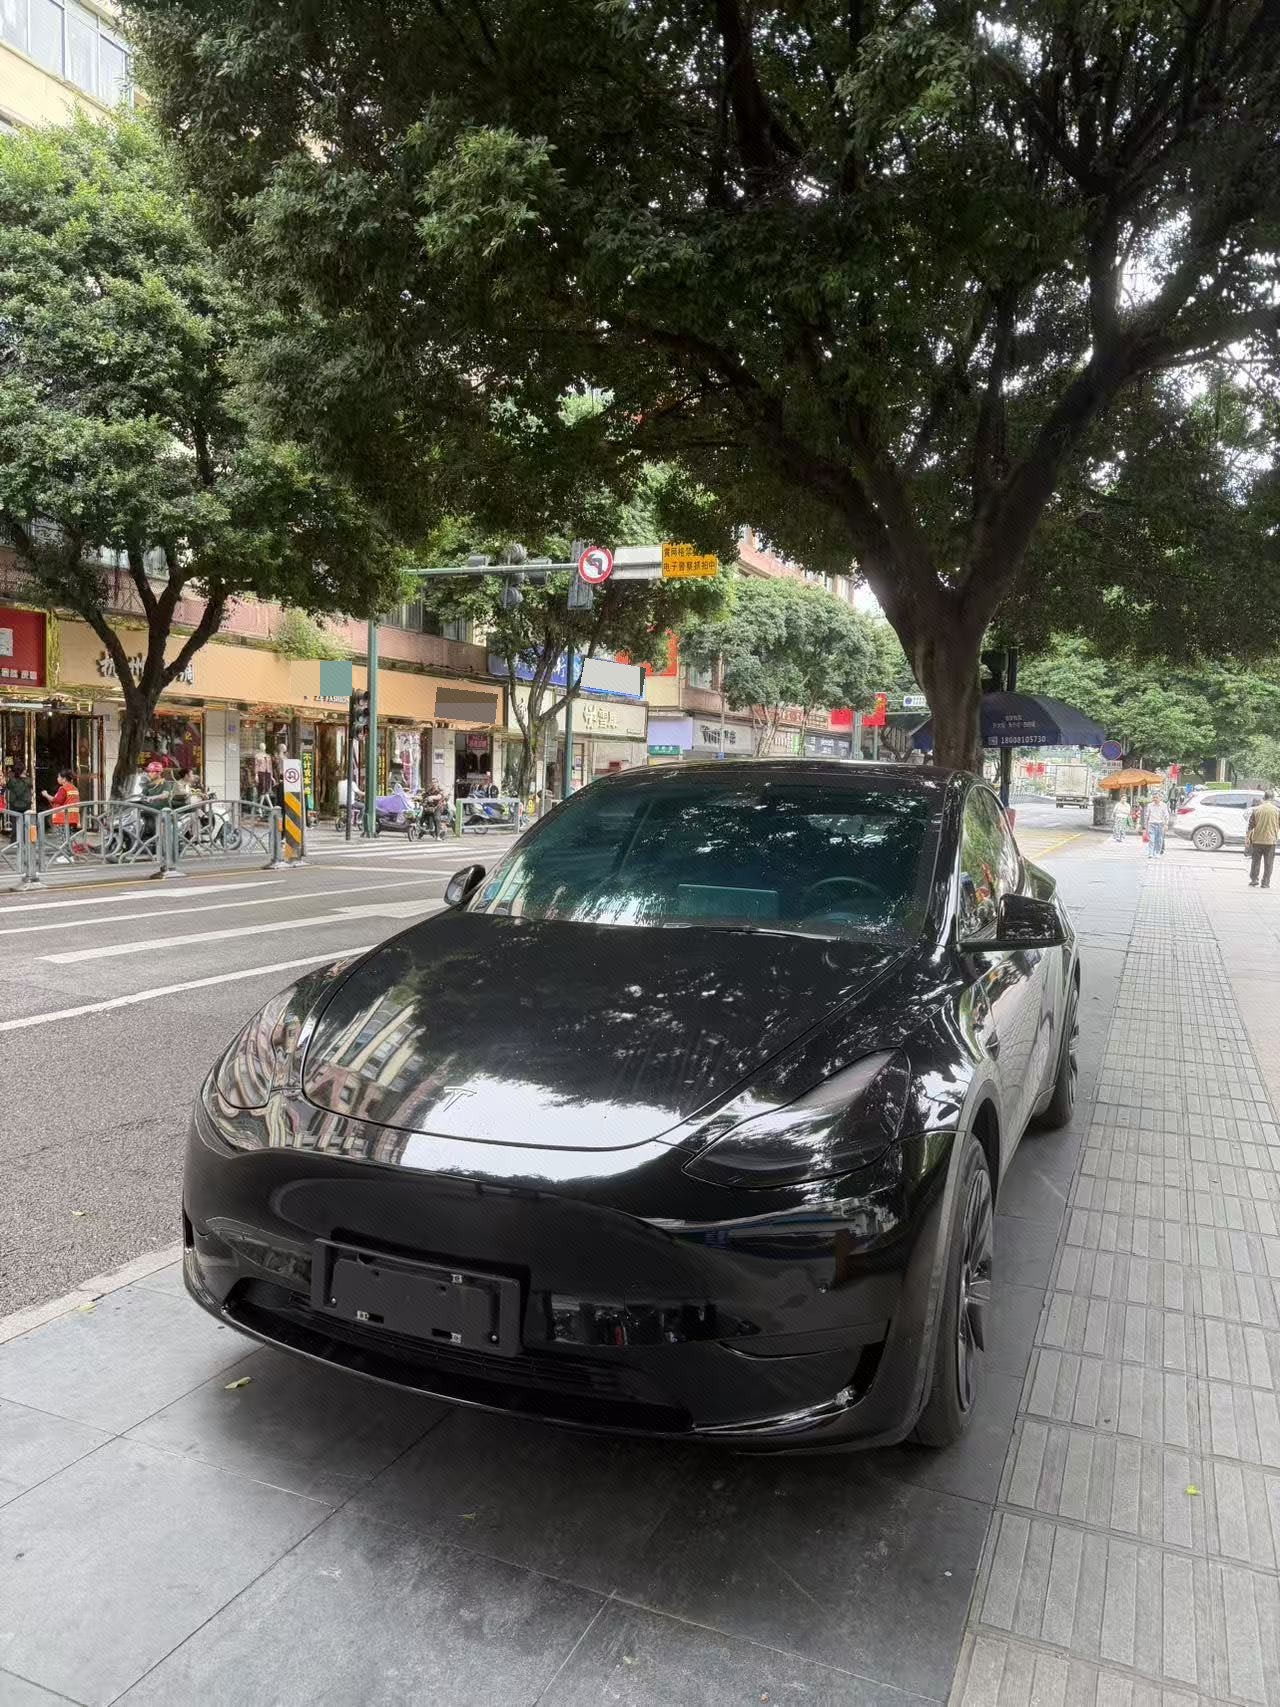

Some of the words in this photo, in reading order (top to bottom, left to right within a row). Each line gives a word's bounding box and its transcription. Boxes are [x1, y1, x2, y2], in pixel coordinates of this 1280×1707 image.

[663, 561, 715, 572] 电子警察抓拍中
